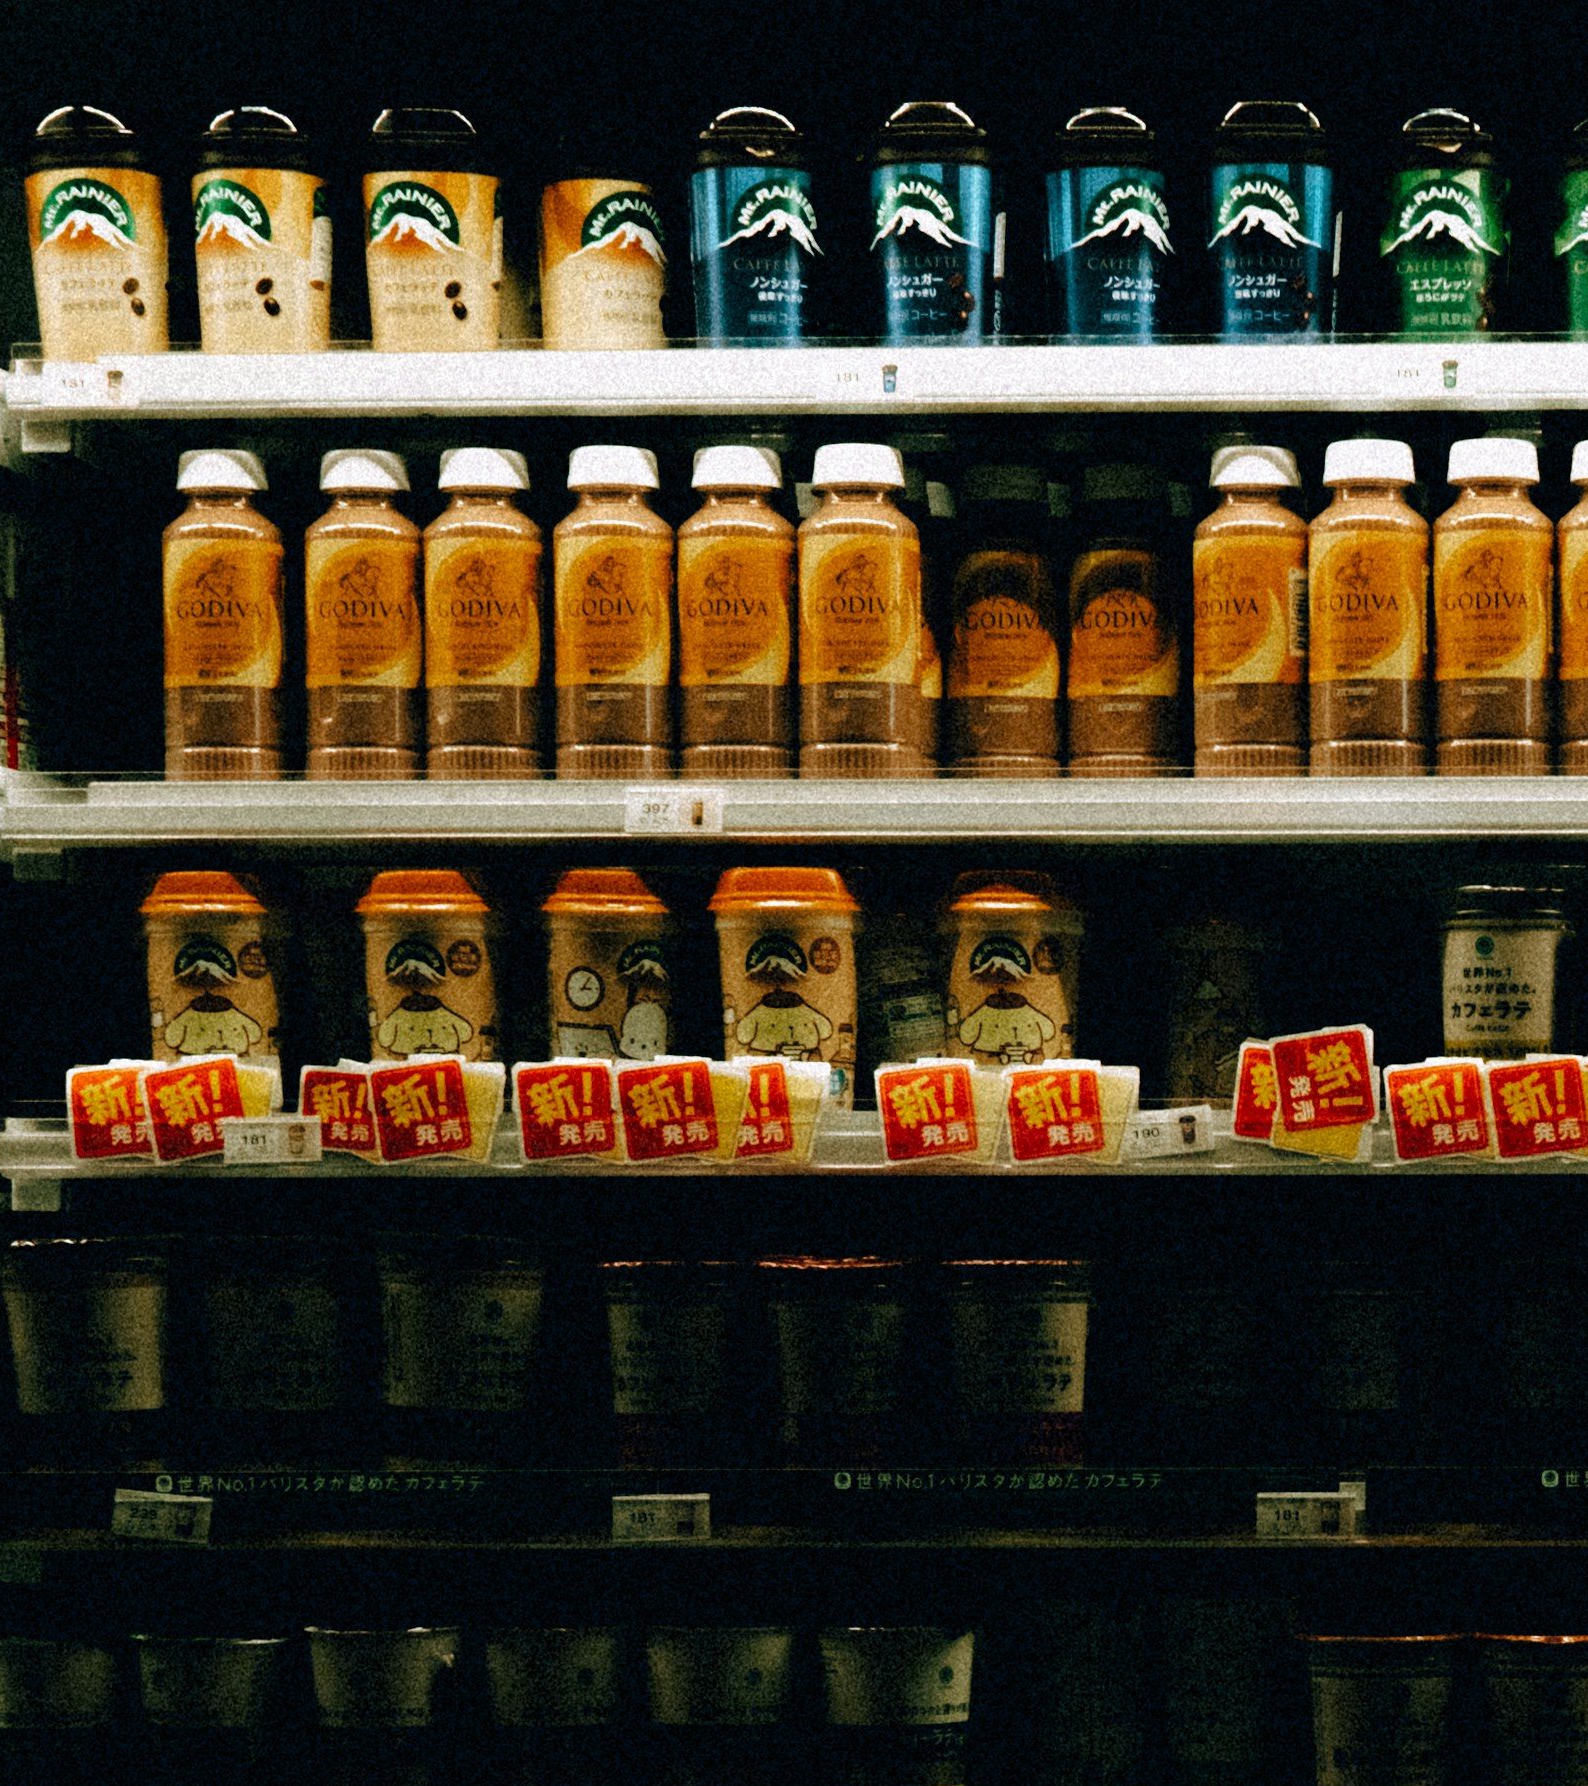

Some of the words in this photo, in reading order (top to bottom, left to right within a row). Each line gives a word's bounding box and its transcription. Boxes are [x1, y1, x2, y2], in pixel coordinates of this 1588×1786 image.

[177, 602, 263, 618] GODIVA
[318, 601, 408, 619] GODIVA
[437, 600, 520, 618] GODIVA
[567, 600, 654, 617] GODIVA
[686, 599, 768, 617] GODIVA
[1317, 594, 1399, 613] GODIVA
[1443, 593, 1528, 611] GODIVA
[1450, 1001, 1532, 1020] カフェラテ
[1307, 1040, 1363, 1110] 新!
[154, 1071, 221, 1126] 新!
[312, 1081, 367, 1122] 新!
[382, 1072, 446, 1126] 新!
[526, 1071, 594, 1127] 新!
[627, 1070, 694, 1127] 新!
[886, 1074, 955, 1128] 新!
[1014, 1073, 1081, 1129] 新!
[1288, 1075, 1315, 1123] 発売
[1398, 1072, 1465, 1127] 新!
[1500, 1069, 1566, 1126] 新!
[329, 1121, 370, 1143] 発売
[415, 1121, 464, 1146] 発売
[559, 1121, 608, 1145] 発売
[661, 1120, 712, 1146] 発売
[920, 1122, 970, 1148] 発売
[1047, 1121, 1096, 1148] 発売
[1432, 1121, 1481, 1146] 発売
[1533, 1119, 1581, 1144] 発売
